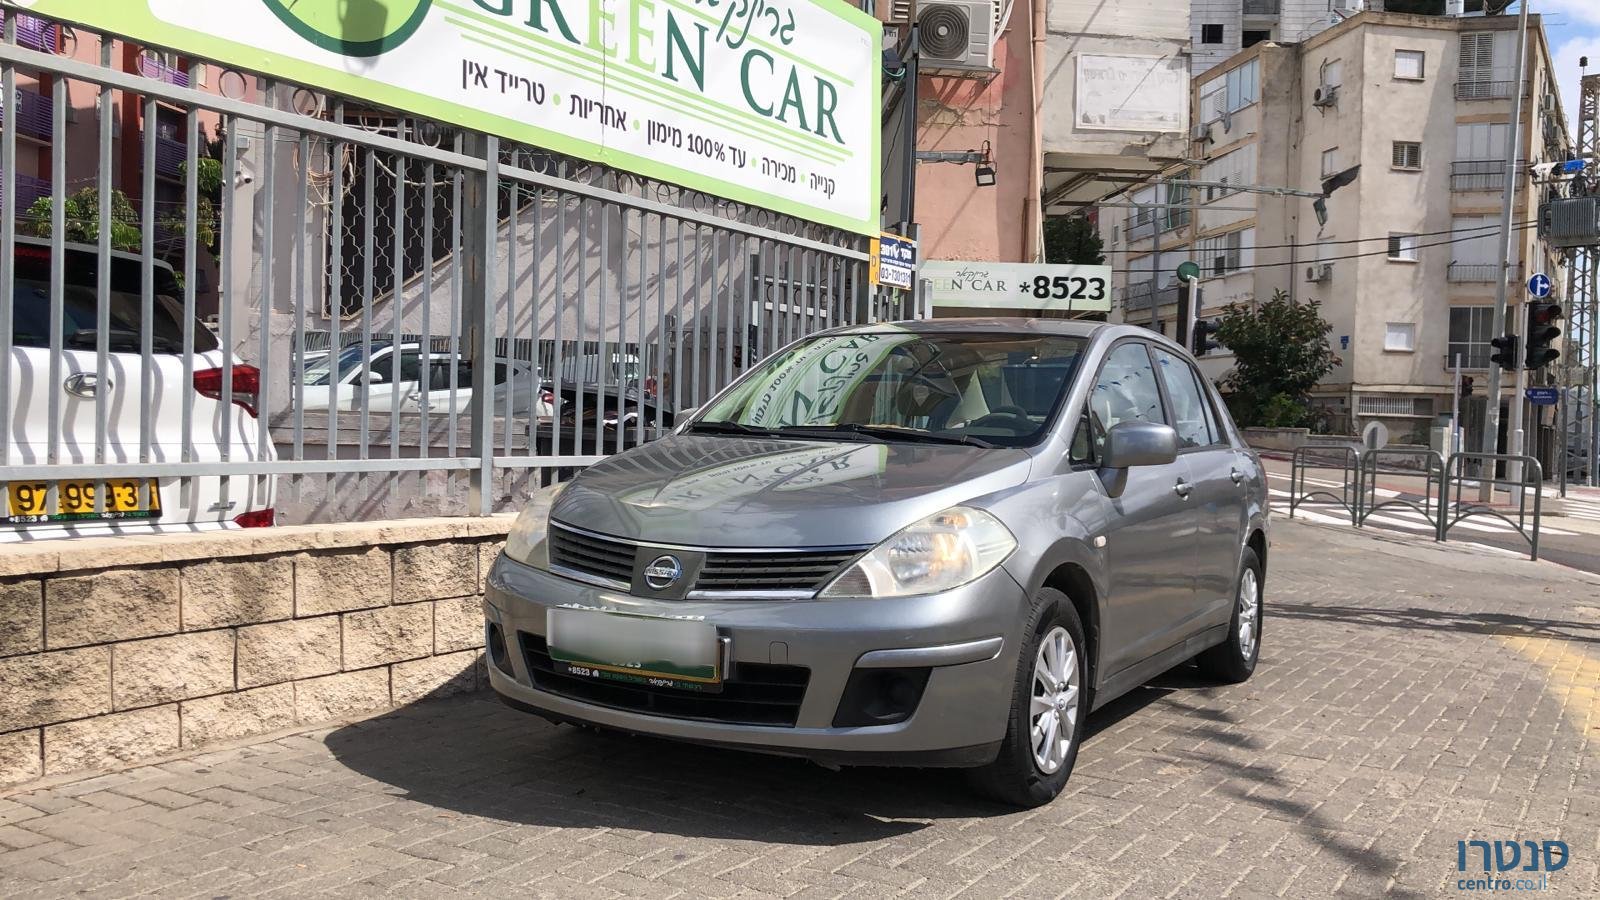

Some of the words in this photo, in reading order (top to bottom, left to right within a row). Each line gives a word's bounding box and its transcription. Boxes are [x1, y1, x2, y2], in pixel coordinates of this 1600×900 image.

[462, 58, 488, 90] אין
[472, 0, 709, 92] EEN
[740, 48, 846, 145] CAR
[494, 68, 546, 105] טרייד
[569, 94, 627, 132] אחריות
[647, 119, 683, 149] מימון
[687, 133, 726, 162] 100%
[728, 145, 747, 168] עד
[762, 156, 796, 183] מכירה
[810, 172, 836, 200] קנייה
[971, 279, 1008, 292] CAR
